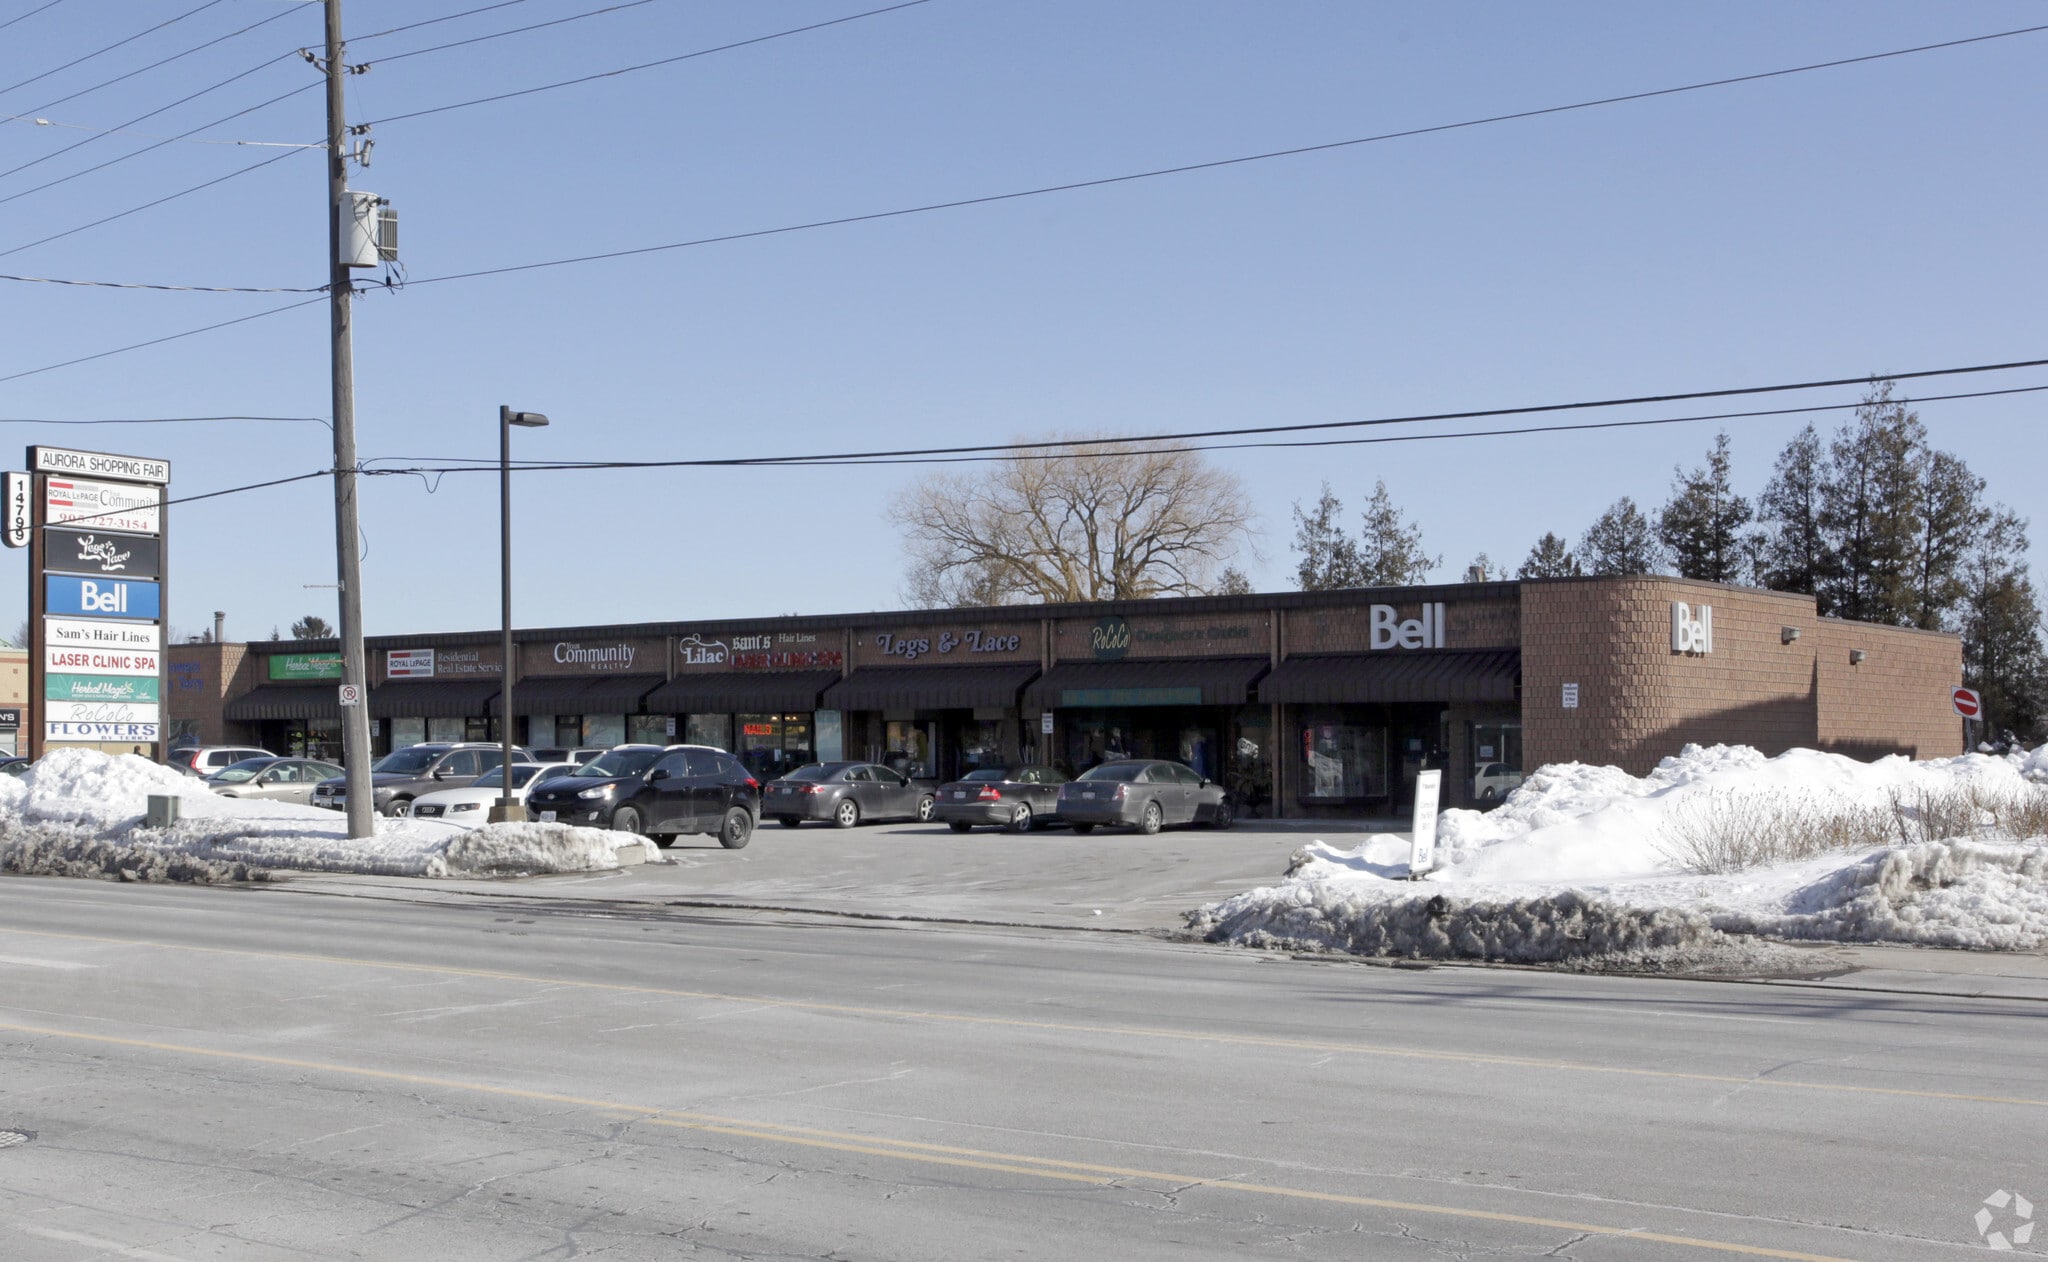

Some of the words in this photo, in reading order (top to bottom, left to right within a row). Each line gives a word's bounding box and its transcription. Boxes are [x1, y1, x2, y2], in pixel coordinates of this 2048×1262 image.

[43, 453, 86, 469] AURORA
[90, 457, 140, 475] SHOPPING
[143, 463, 164, 477] FAIR
[49, 489, 70, 499] ROYAL
[100, 489, 158, 517] Community
[15, 480, 24, 541] 14799
[59, 512, 148, 530] 905-727-3154
[81, 581, 127, 613] Bell
[56, 627, 90, 640] Sam's
[94, 630, 119, 642] Hair
[122, 631, 151, 643] Lines
[1370, 602, 1446, 650] Bell
[1672, 601, 1713, 653] Bell
[778, 632, 795, 644] Hair
[796, 632, 817, 643] Lines
[877, 633, 930, 659] Legs
[937, 632, 960, 653] &
[964, 630, 1020, 652] Lace
[52, 652, 90, 667] LASER
[93, 655, 131, 669] CLINIC
[134, 657, 156, 670] SPA
[390, 658, 408, 668] ROYAL
[437, 650, 479, 662] Residential
[554, 642, 635, 669] Community
[682, 643, 726, 665] Lilac
[437, 663, 454, 674] Real
[455, 662, 478, 673] Estate
[478, 660, 503, 673] Servic
[71, 681, 101, 695] Herbal
[103, 682, 127, 699] Magic
[70, 703, 134, 722] RoCoCo
[50, 722, 156, 736] FLOWERS
[743, 724, 772, 736] NAILS
